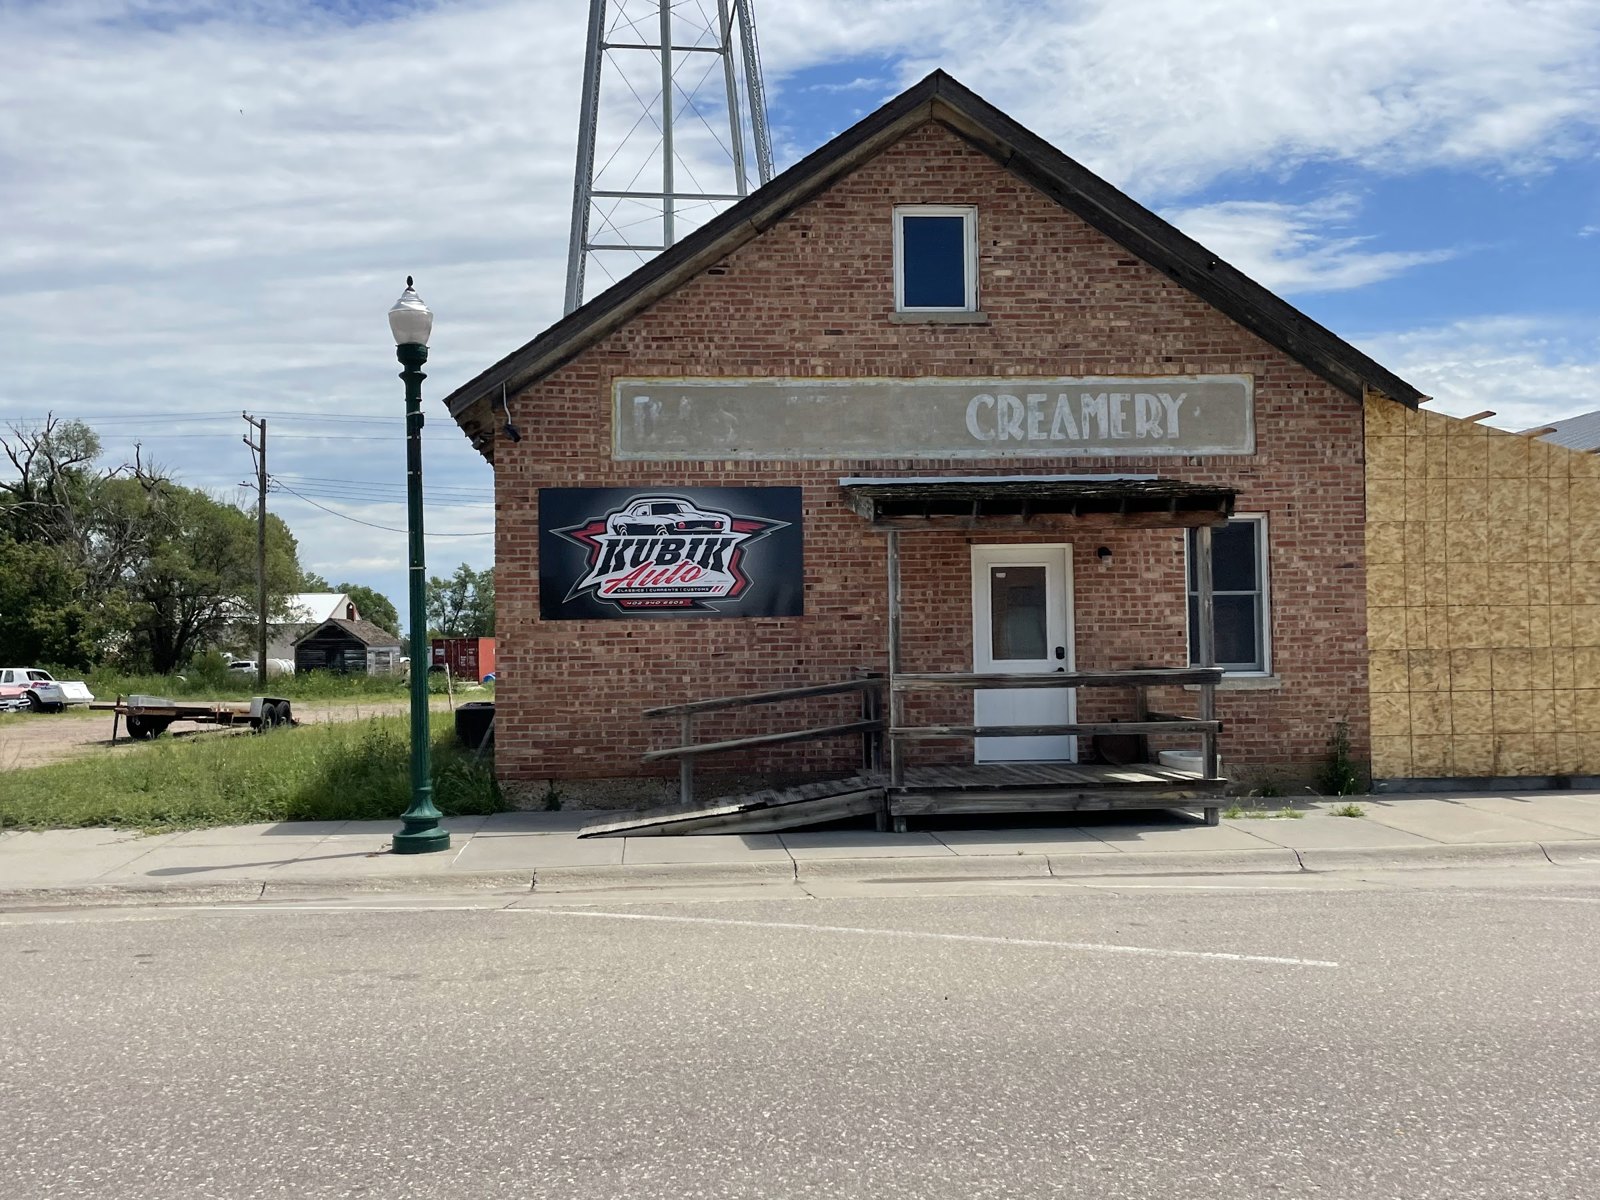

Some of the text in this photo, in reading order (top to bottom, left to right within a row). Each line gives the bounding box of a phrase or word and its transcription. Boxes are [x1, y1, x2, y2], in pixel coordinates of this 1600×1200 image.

[965, 391, 1184, 443] CREAMERY
[596, 537, 732, 577] KUBIK
[604, 560, 708, 595] Auto
